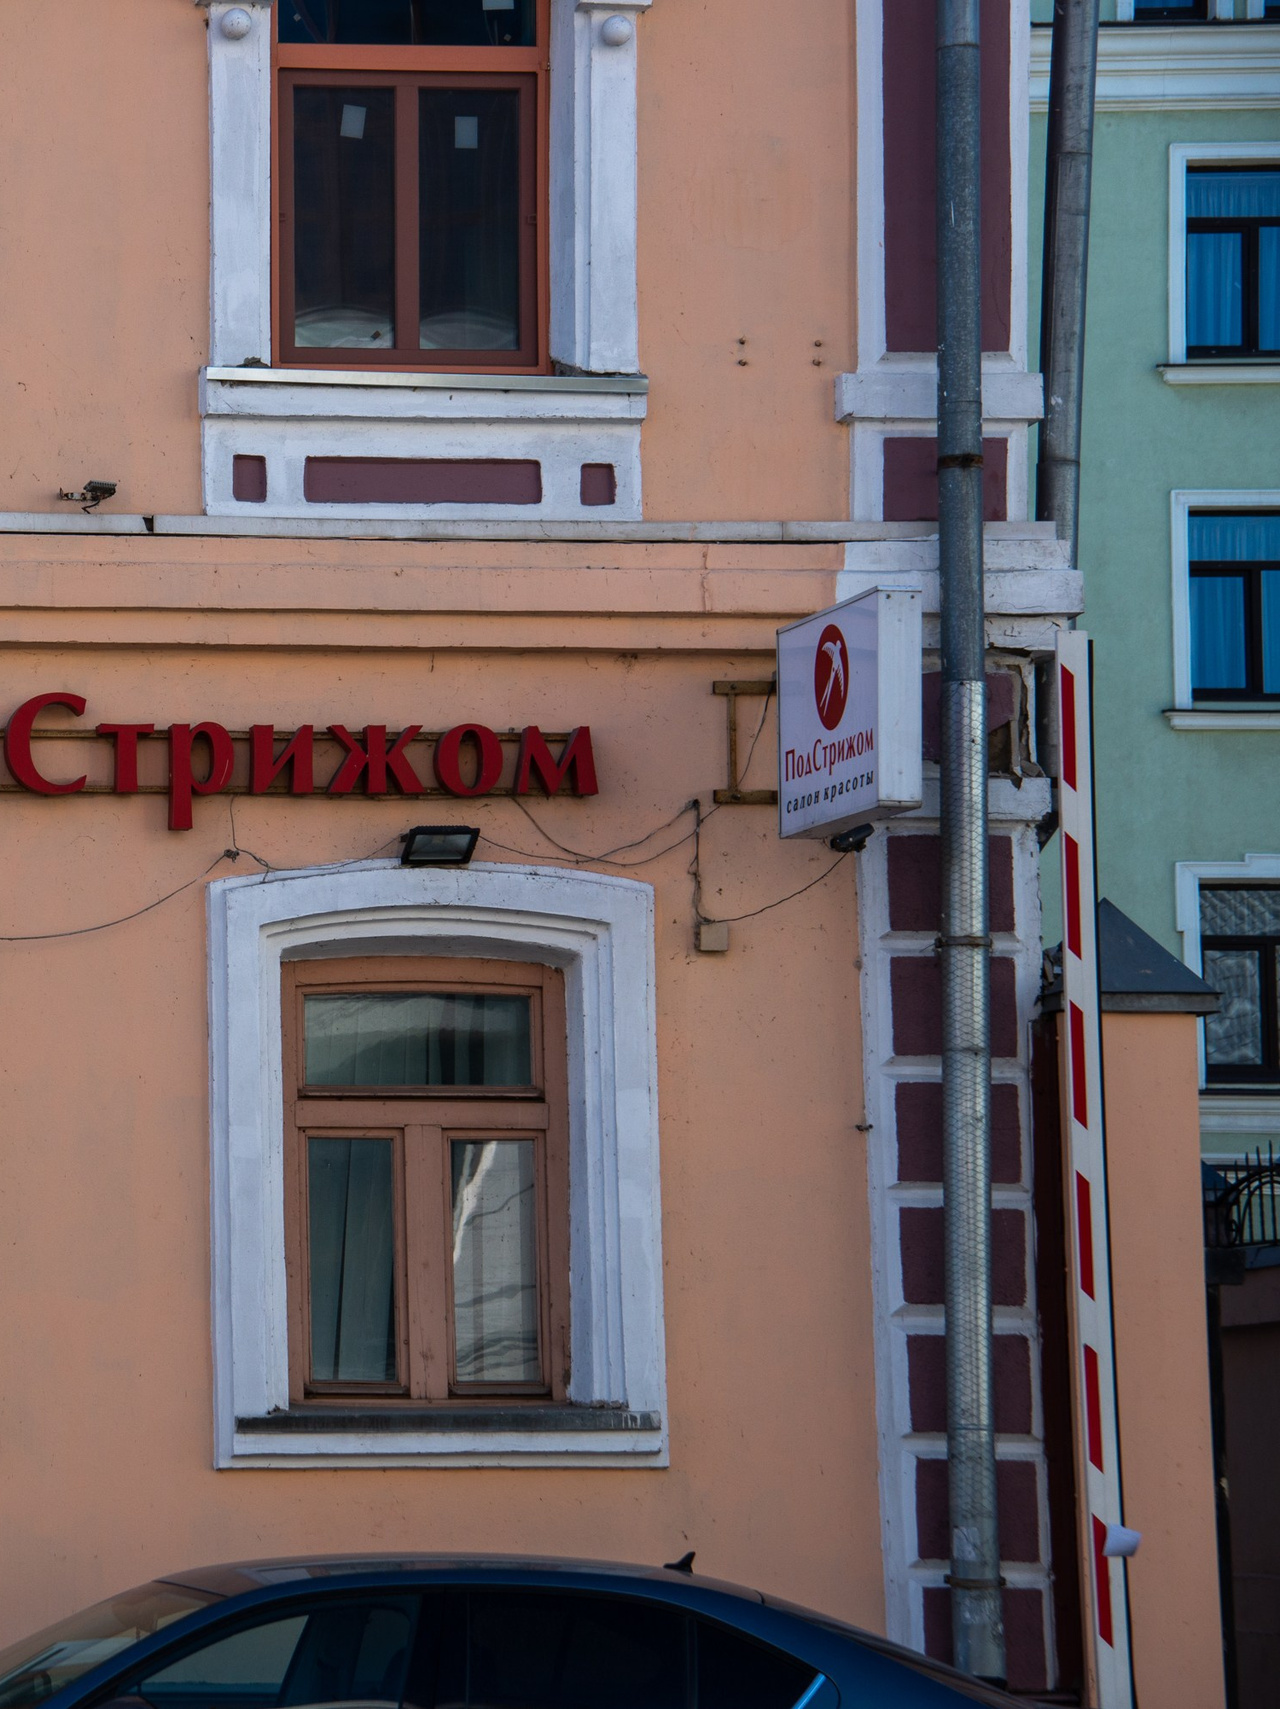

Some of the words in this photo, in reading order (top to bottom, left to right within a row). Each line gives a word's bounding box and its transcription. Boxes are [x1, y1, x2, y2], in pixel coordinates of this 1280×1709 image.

[785, 728, 874, 782] ПодСтрижом
[786, 789, 820, 814] салон
[823, 770, 874, 803] красоты
